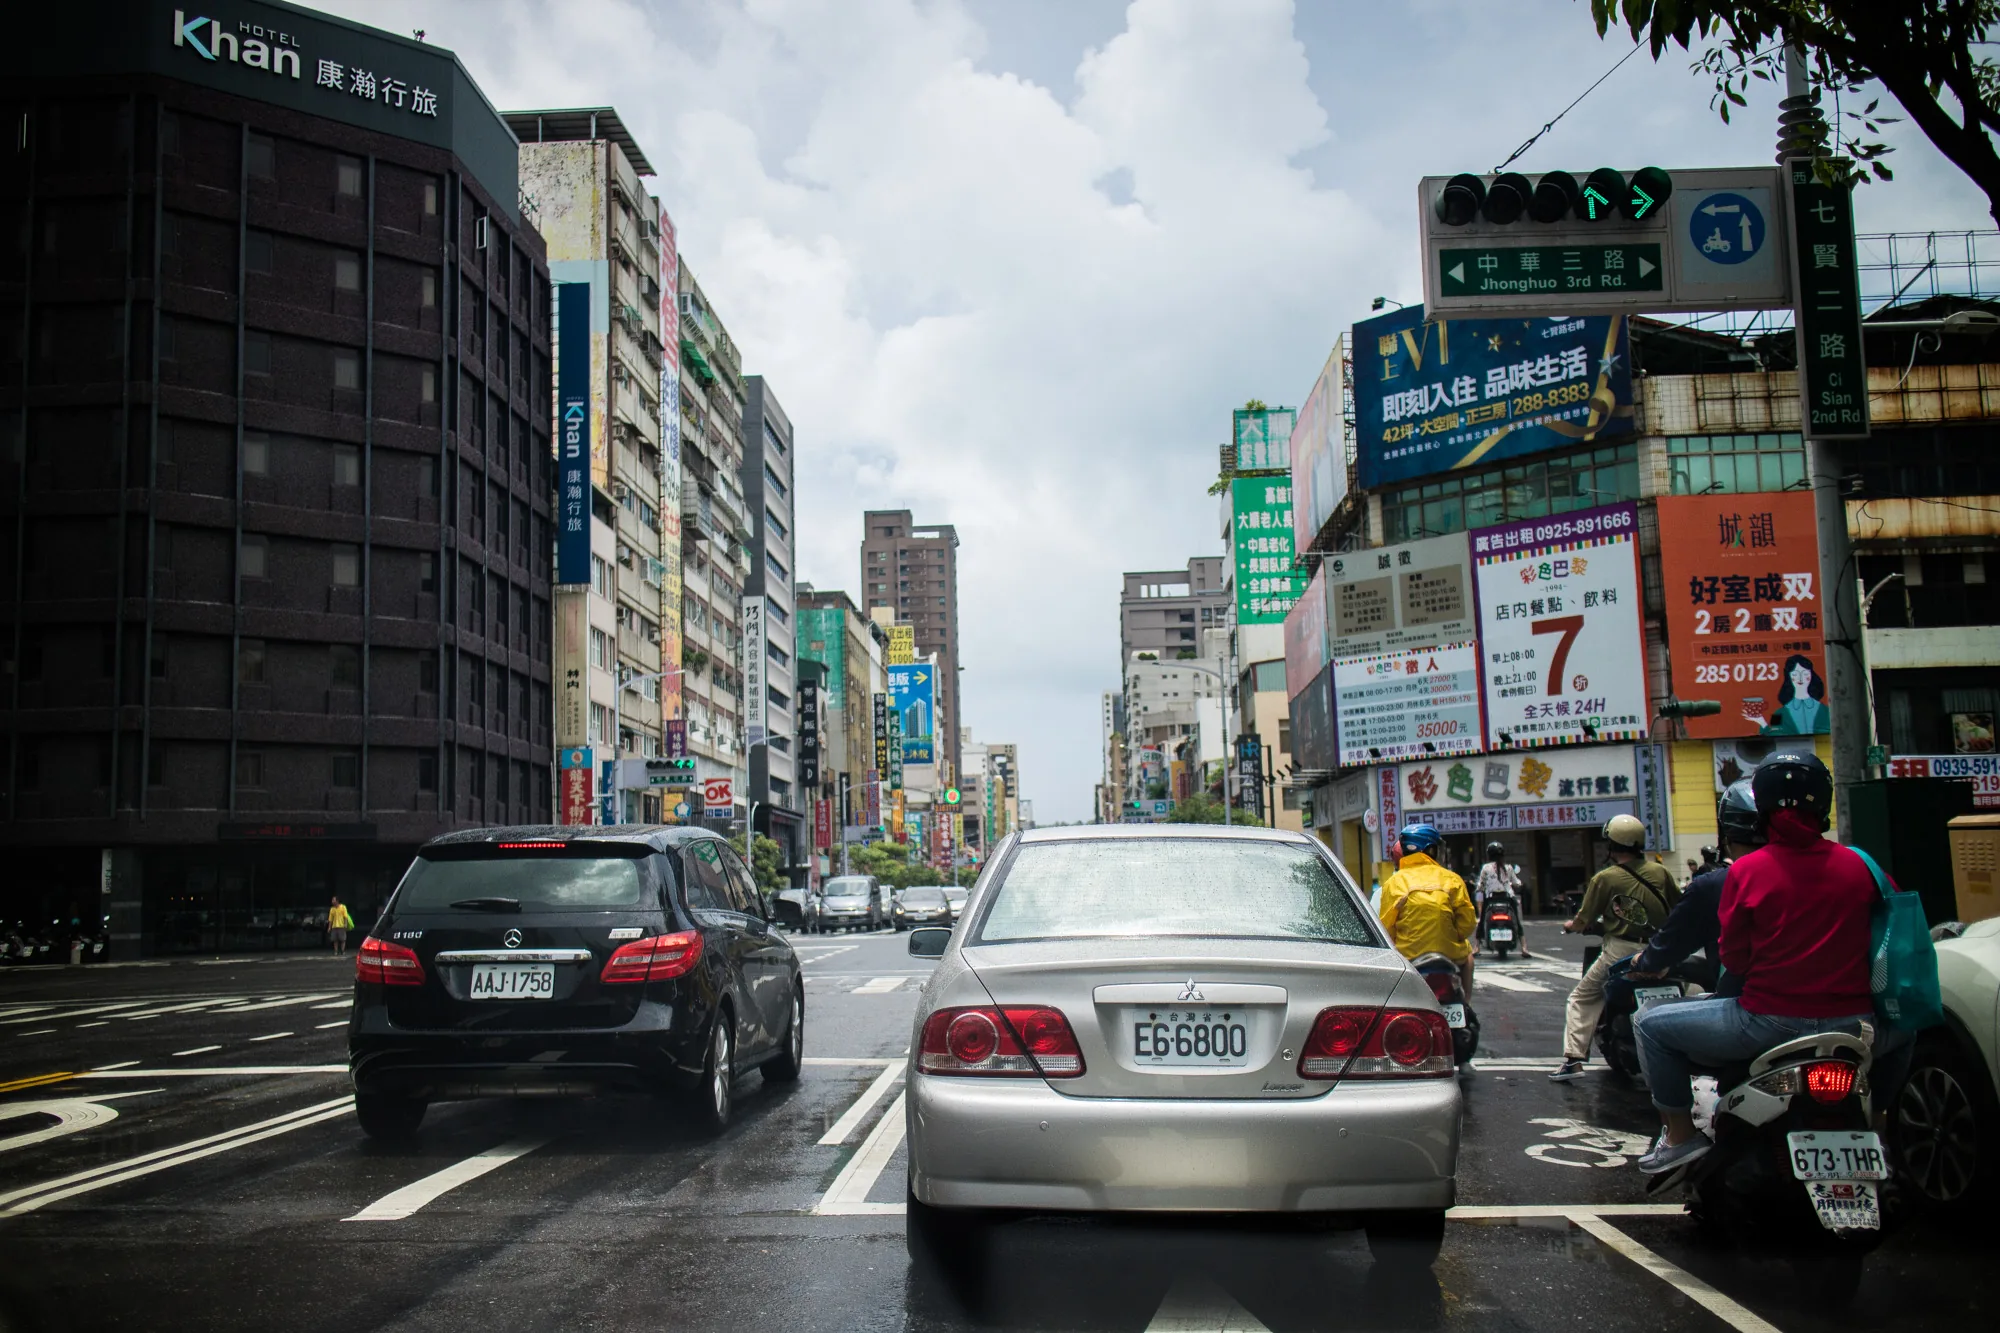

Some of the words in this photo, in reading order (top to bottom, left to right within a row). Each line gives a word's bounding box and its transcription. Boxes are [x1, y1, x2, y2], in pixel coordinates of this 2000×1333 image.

[173, 9, 300, 79] Khan
[239, 21, 300, 48] HOTEL
[315, 58, 438, 117] 康瀚行旅
[1793, 171, 1807, 184] 西
[1477, 249, 1625, 273] 中華三路
[1480, 277, 1557, 292] Jhonghuo
[1567, 275, 1592, 288] 3rd
[1601, 274, 1627, 287] Rd.
[1809, 200, 1846, 359] 七賢二路
[1541, 319, 1586, 339] 七賢路右轉
[1382, 375, 1478, 424] 即刻入住
[1484, 345, 1588, 400] 品味生活
[1828, 373, 1842, 386] Ci
[1512, 382, 1590, 417] 288-8383
[1821, 391, 1851, 405] Sian
[1811, 410, 1837, 424] 2nd
[565, 401, 584, 458] Khan
[566, 469, 583, 532] 康瀚行旅
[1476, 528, 1535, 552] 廣告出租
[1536, 511, 1631, 542] 0925-891666
[1247, 537, 1290, 553] 中風老化
[1377, 550, 1412, 570] 誠徵
[1519, 556, 1588, 585] 彩色巴黎
[1690, 572, 1815, 605] 好室成双
[1366, 660, 1402, 676] 彩色巴黎
[1405, 656, 1439, 675] 徵人
[1492, 649, 1535, 664] 早上08:00
[1531, 614, 1585, 697] 7
[1575, 677, 1587, 691] 折
[1493, 671, 1537, 686] 晚上21:00
[1695, 665, 1729, 684] 285
[1733, 662, 1779, 682] 0123
[1524, 701, 1571, 720] 全天候
[1574, 698, 1606, 715] 24H
[1369, 725, 1406, 735] 12:00-23:00
[1408, 757, 1553, 805] 彩色巴黎
[1558, 775, 1630, 797] 流行餐飲
[705, 784, 732, 801] OK
[1487, 809, 1508, 827] 7折
[1169, 1011, 1213, 1023] 台灣省
